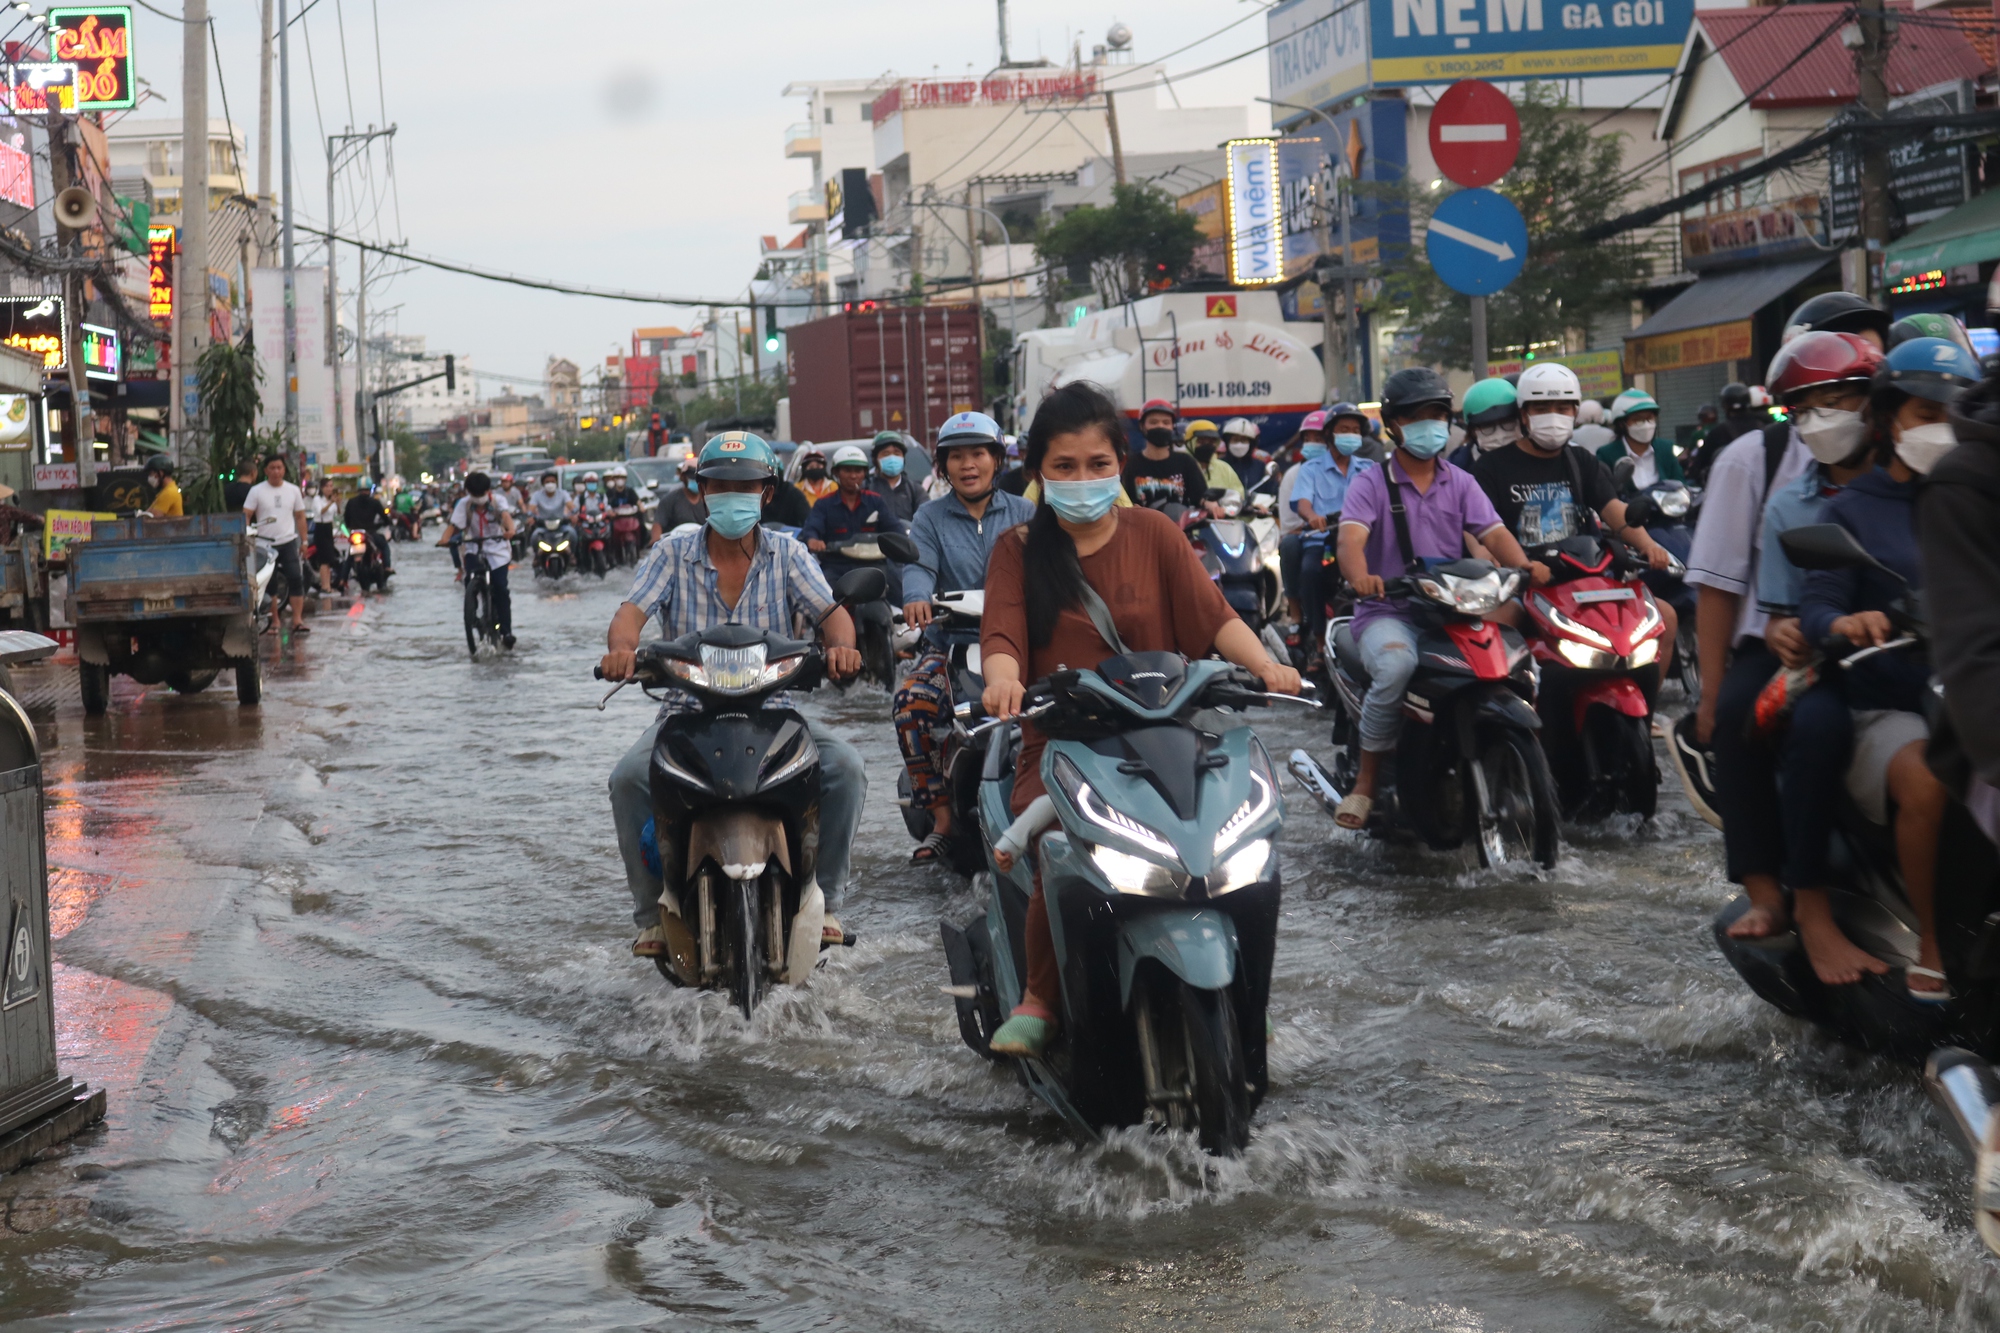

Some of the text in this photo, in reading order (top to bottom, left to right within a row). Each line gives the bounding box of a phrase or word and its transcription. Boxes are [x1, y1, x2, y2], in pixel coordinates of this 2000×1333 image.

[1561, 3, 1604, 30] GA
[1521, 52, 1649, 70] www.vuanem.com
[1250, 224, 1271, 273] vua
[1177, 380, 1272, 400] 50H-180.89
[1130, 671, 1168, 680] HONDA
[716, 712, 749, 720] HONDA
